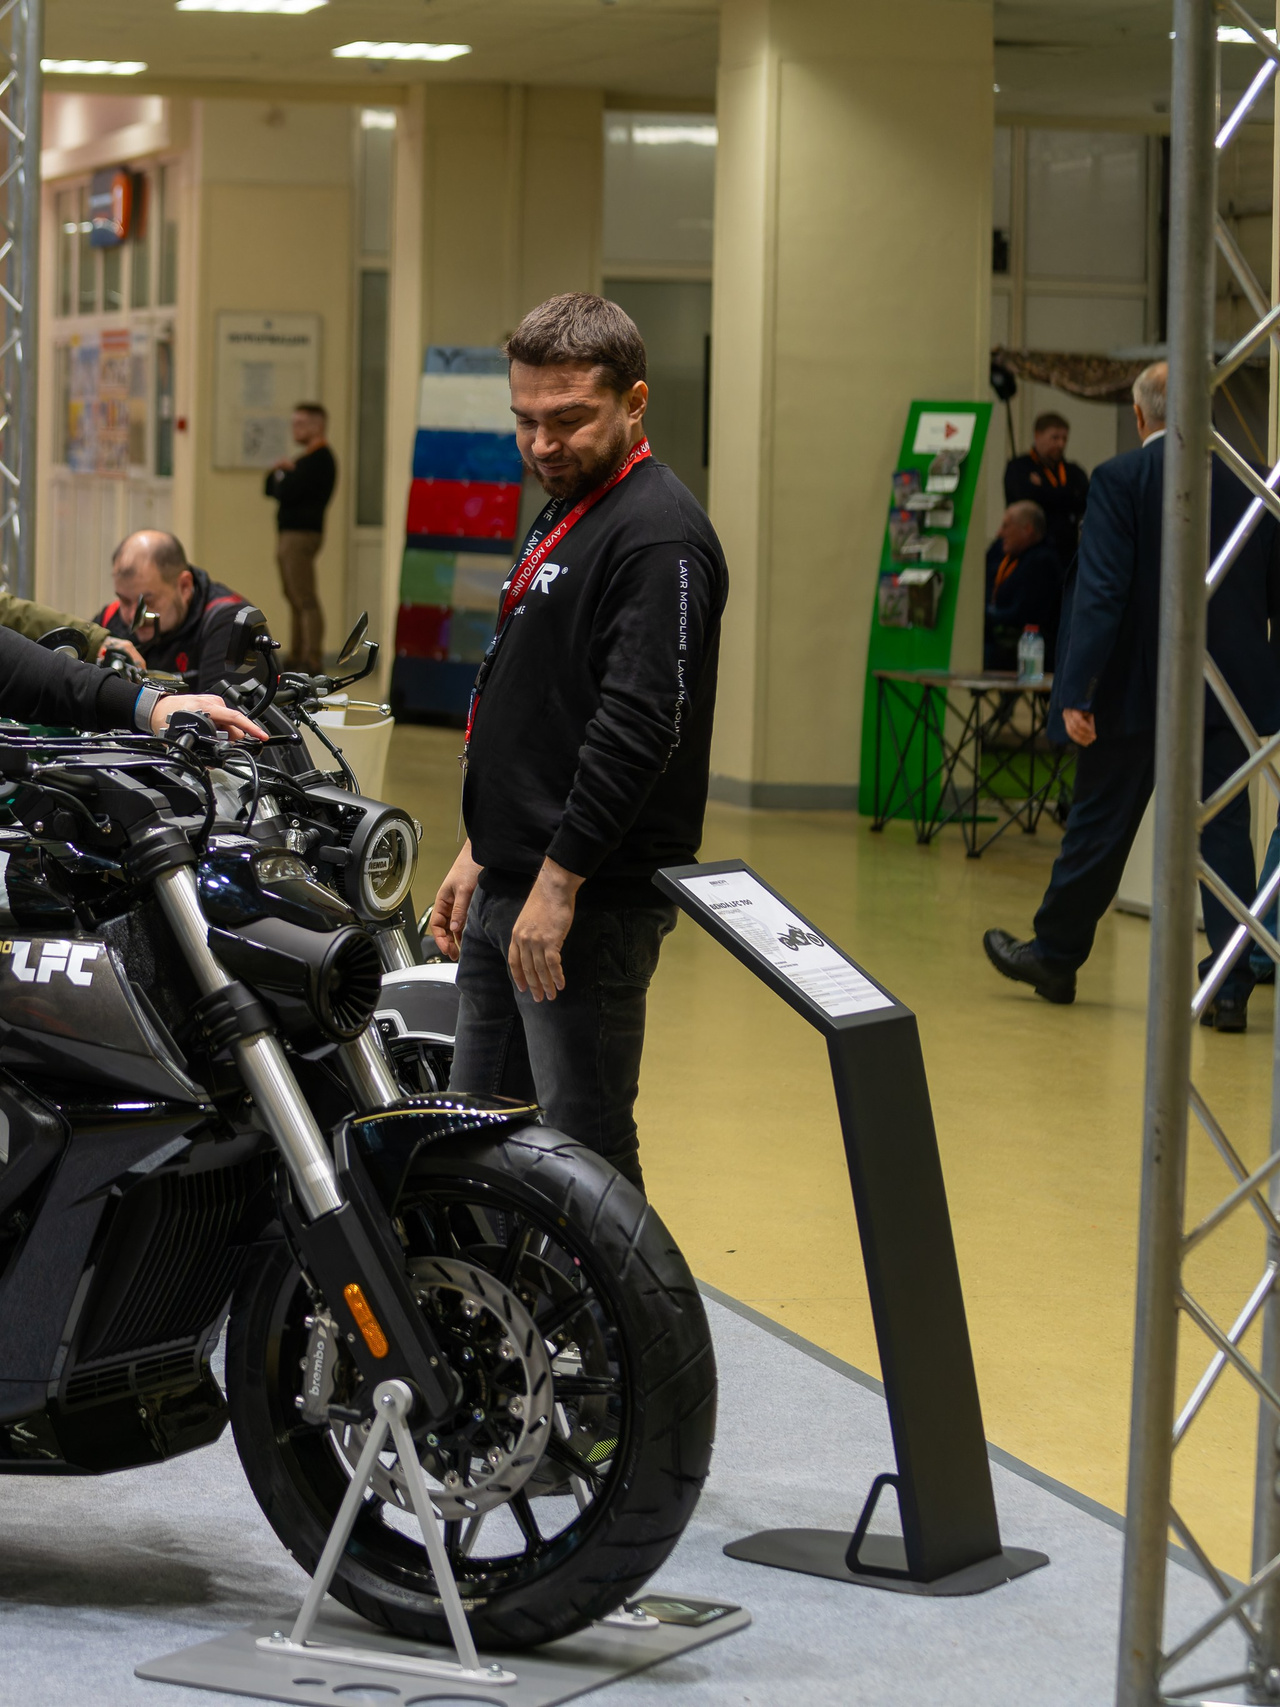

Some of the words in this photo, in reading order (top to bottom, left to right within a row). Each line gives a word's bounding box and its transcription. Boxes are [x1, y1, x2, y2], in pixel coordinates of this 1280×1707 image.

[523, 529, 543, 557] LAVR
[544, 522, 568, 548] LAVR
[510, 546, 546, 598] MOTOLINE
[678, 559, 688, 589] LAVR
[678, 591, 688, 651] MOTOLINE
[11, 940, 100, 987] LFC
[308, 1340, 326, 1397] brembo
